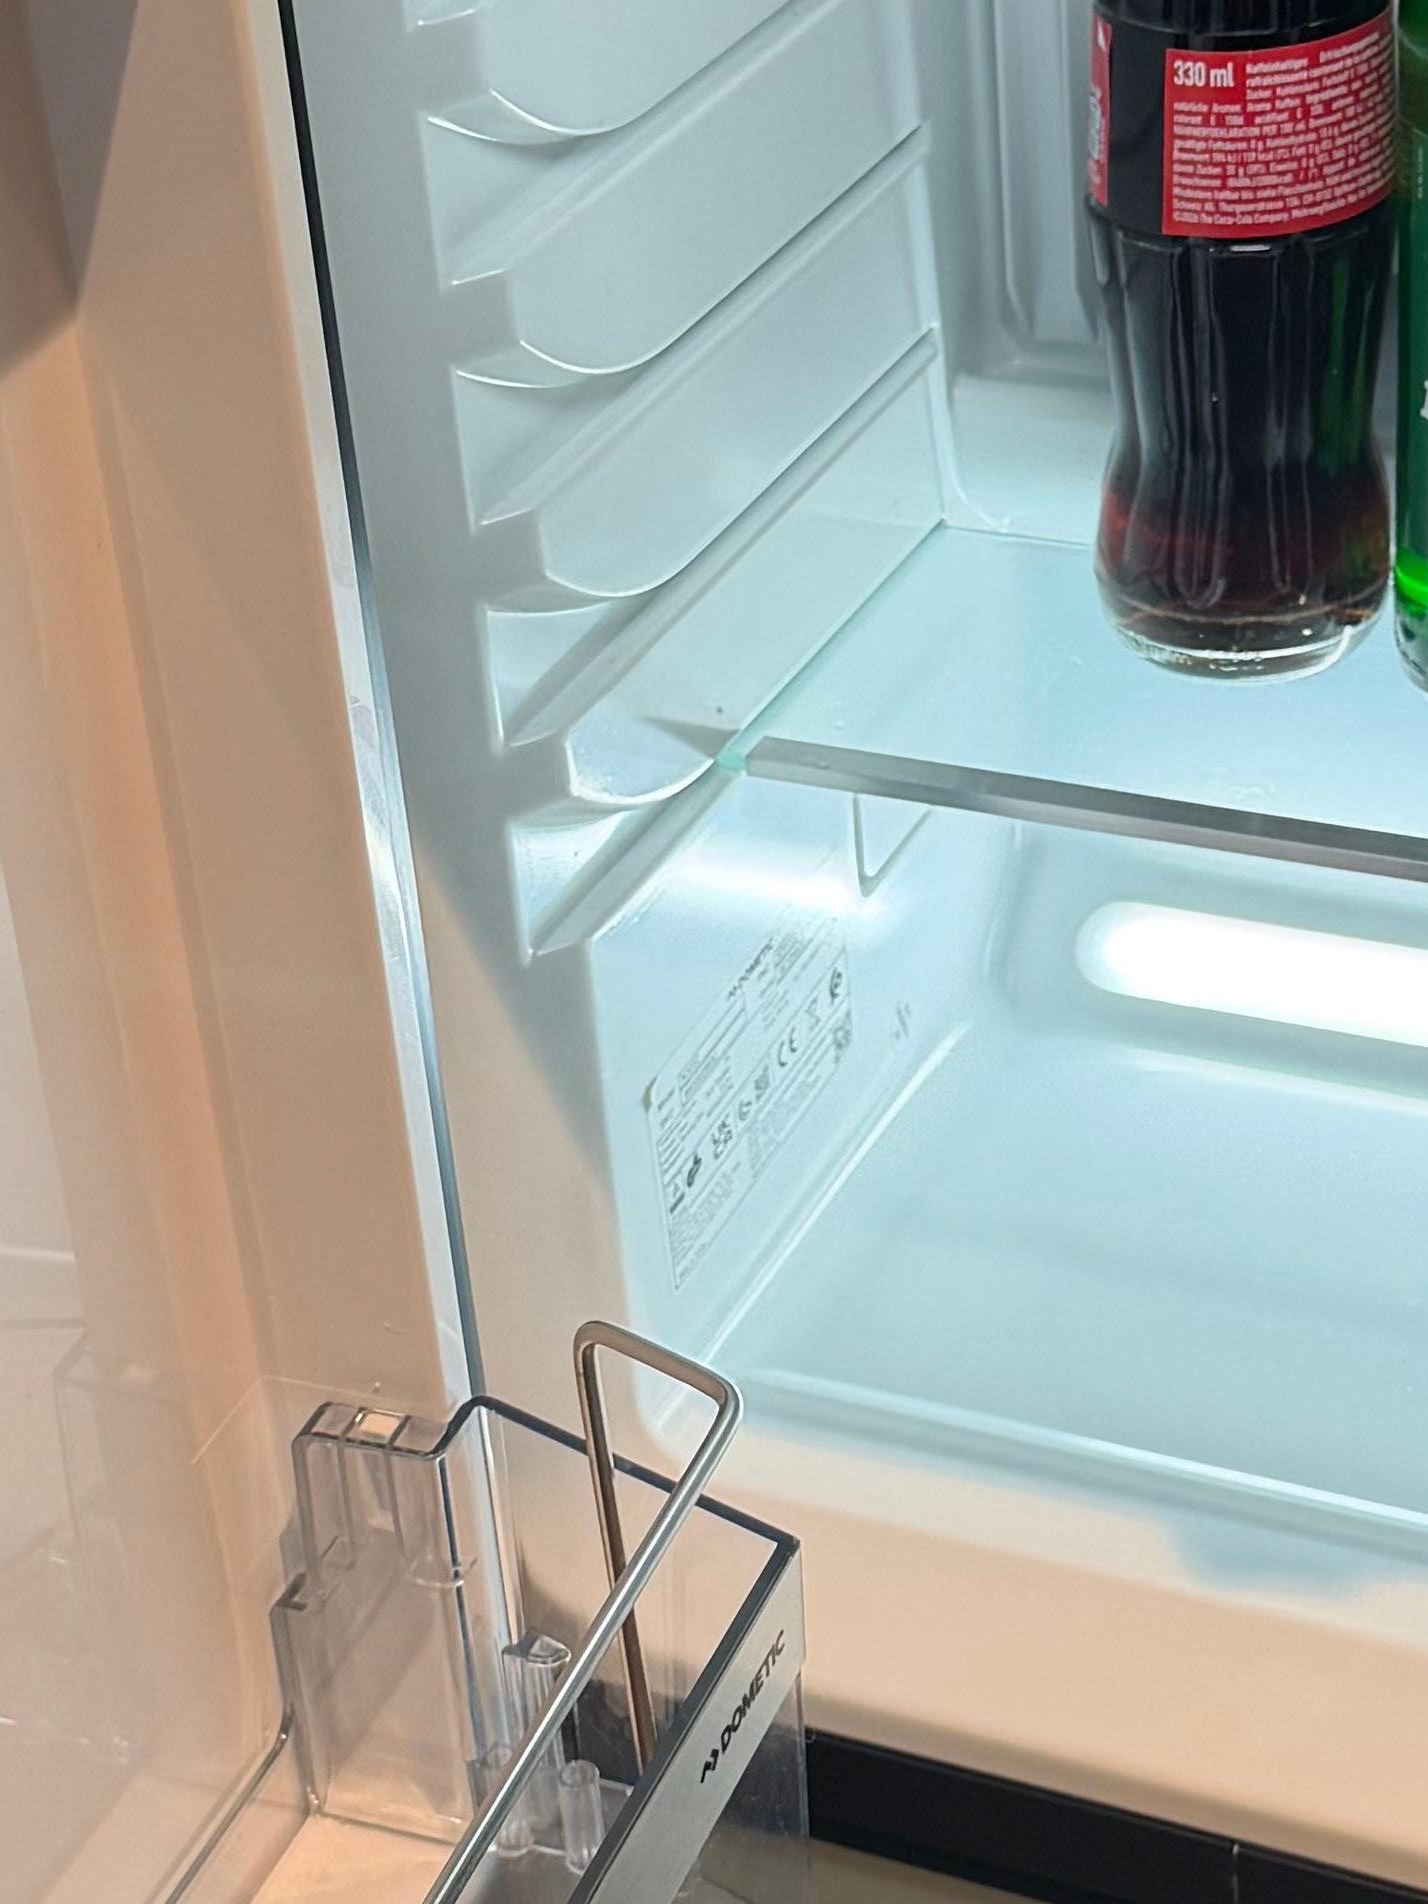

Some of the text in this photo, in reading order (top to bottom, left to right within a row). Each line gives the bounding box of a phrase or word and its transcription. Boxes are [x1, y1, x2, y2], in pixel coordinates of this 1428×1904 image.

[1173, 60, 1234, 88] 330 ml
[720, 1628, 786, 1756] DOMETIC
